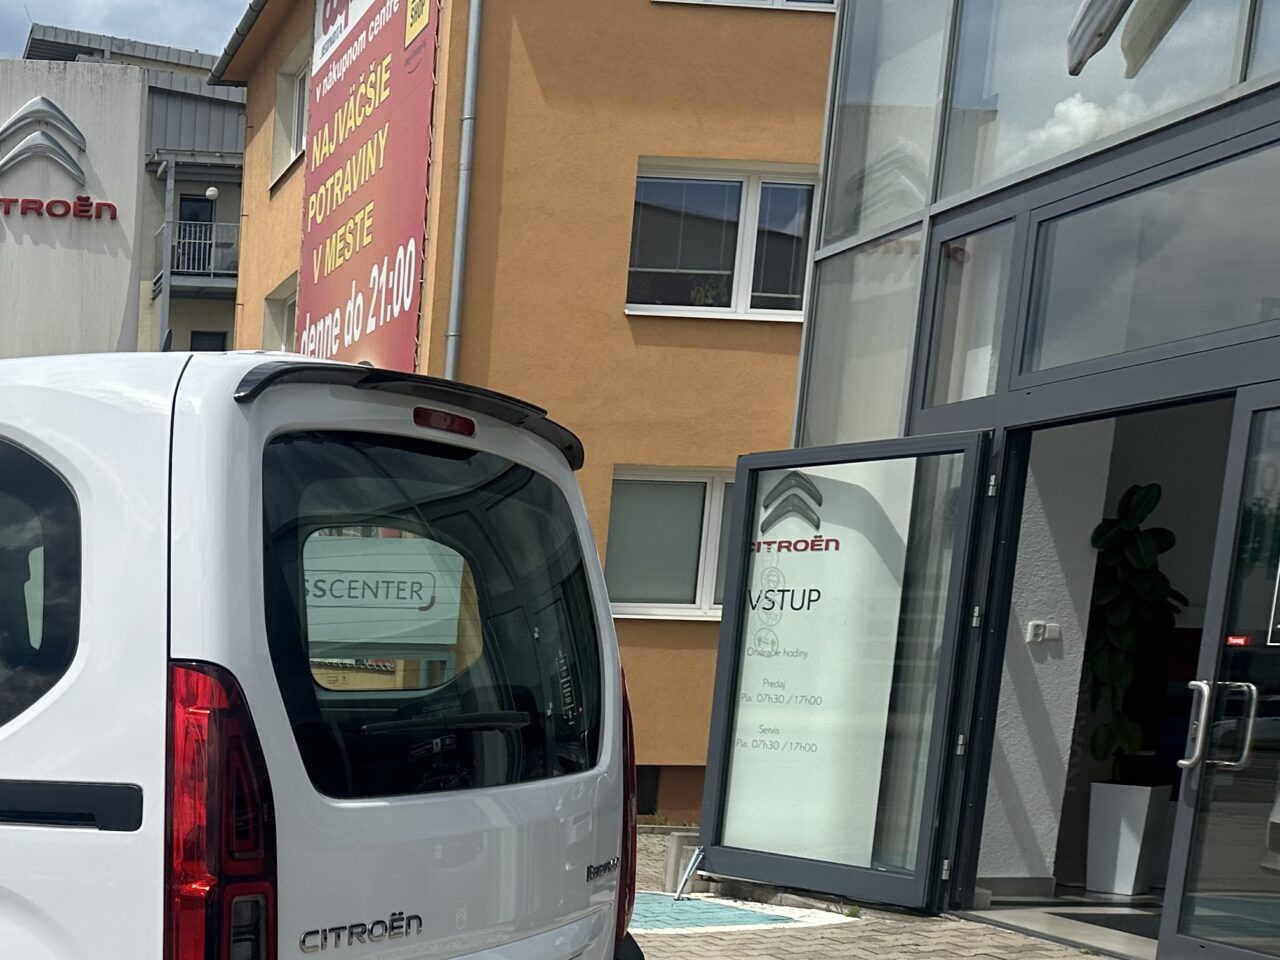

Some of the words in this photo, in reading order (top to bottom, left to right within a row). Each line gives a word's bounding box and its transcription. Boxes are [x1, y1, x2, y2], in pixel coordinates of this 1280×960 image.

[315, 83, 322, 103] v
[322, 29, 366, 97] nákupnom
[311, 53, 392, 173] NAJVÄČŠIE
[307, 121, 390, 233] POTRAVINY
[313, 244, 323, 285] V
[324, 201, 375, 278] MESTE
[301, 312, 341, 359] denne
[344, 279, 364, 348] do
[366, 237, 416, 335] 21:00
[747, 588, 822, 612] VSTUP
[783, 647, 809, 660] hodiny
[756, 693, 785, 705] 07h30
[795, 694, 823, 706] 17h00
[762, 678, 786, 690] Predaj
[751, 738, 780, 751] 07h30
[790, 741, 818, 754] 17h00
[759, 724, 781, 735] Servis
[299, 911, 423, 954] CITROËN
